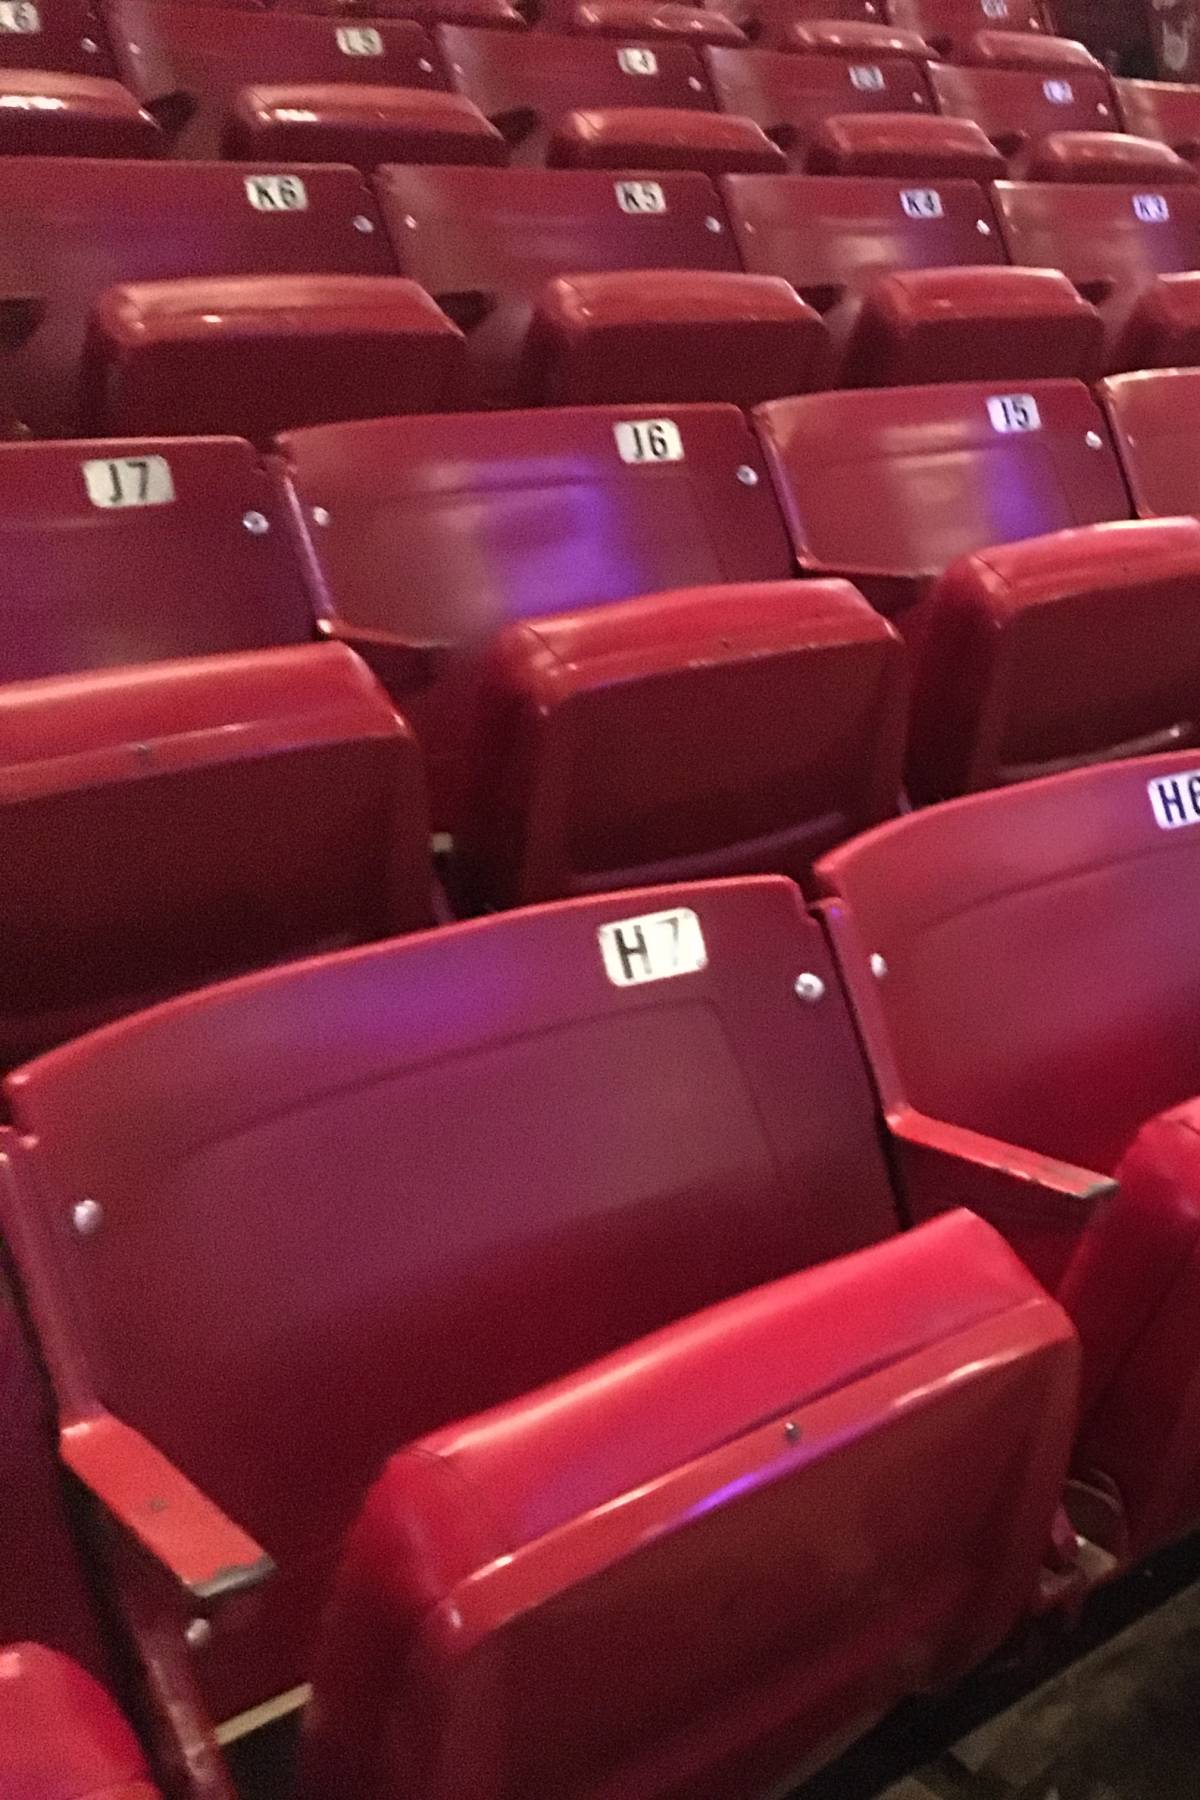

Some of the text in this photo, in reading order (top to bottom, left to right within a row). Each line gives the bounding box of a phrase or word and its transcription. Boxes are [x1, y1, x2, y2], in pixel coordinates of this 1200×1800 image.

[254, 180, 298, 207] K6
[622, 183, 657, 210] K5
[906, 192, 936, 216] K4
[632, 424, 668, 460] J6
[109, 461, 149, 503] J7
[614, 916, 680, 979] H7
